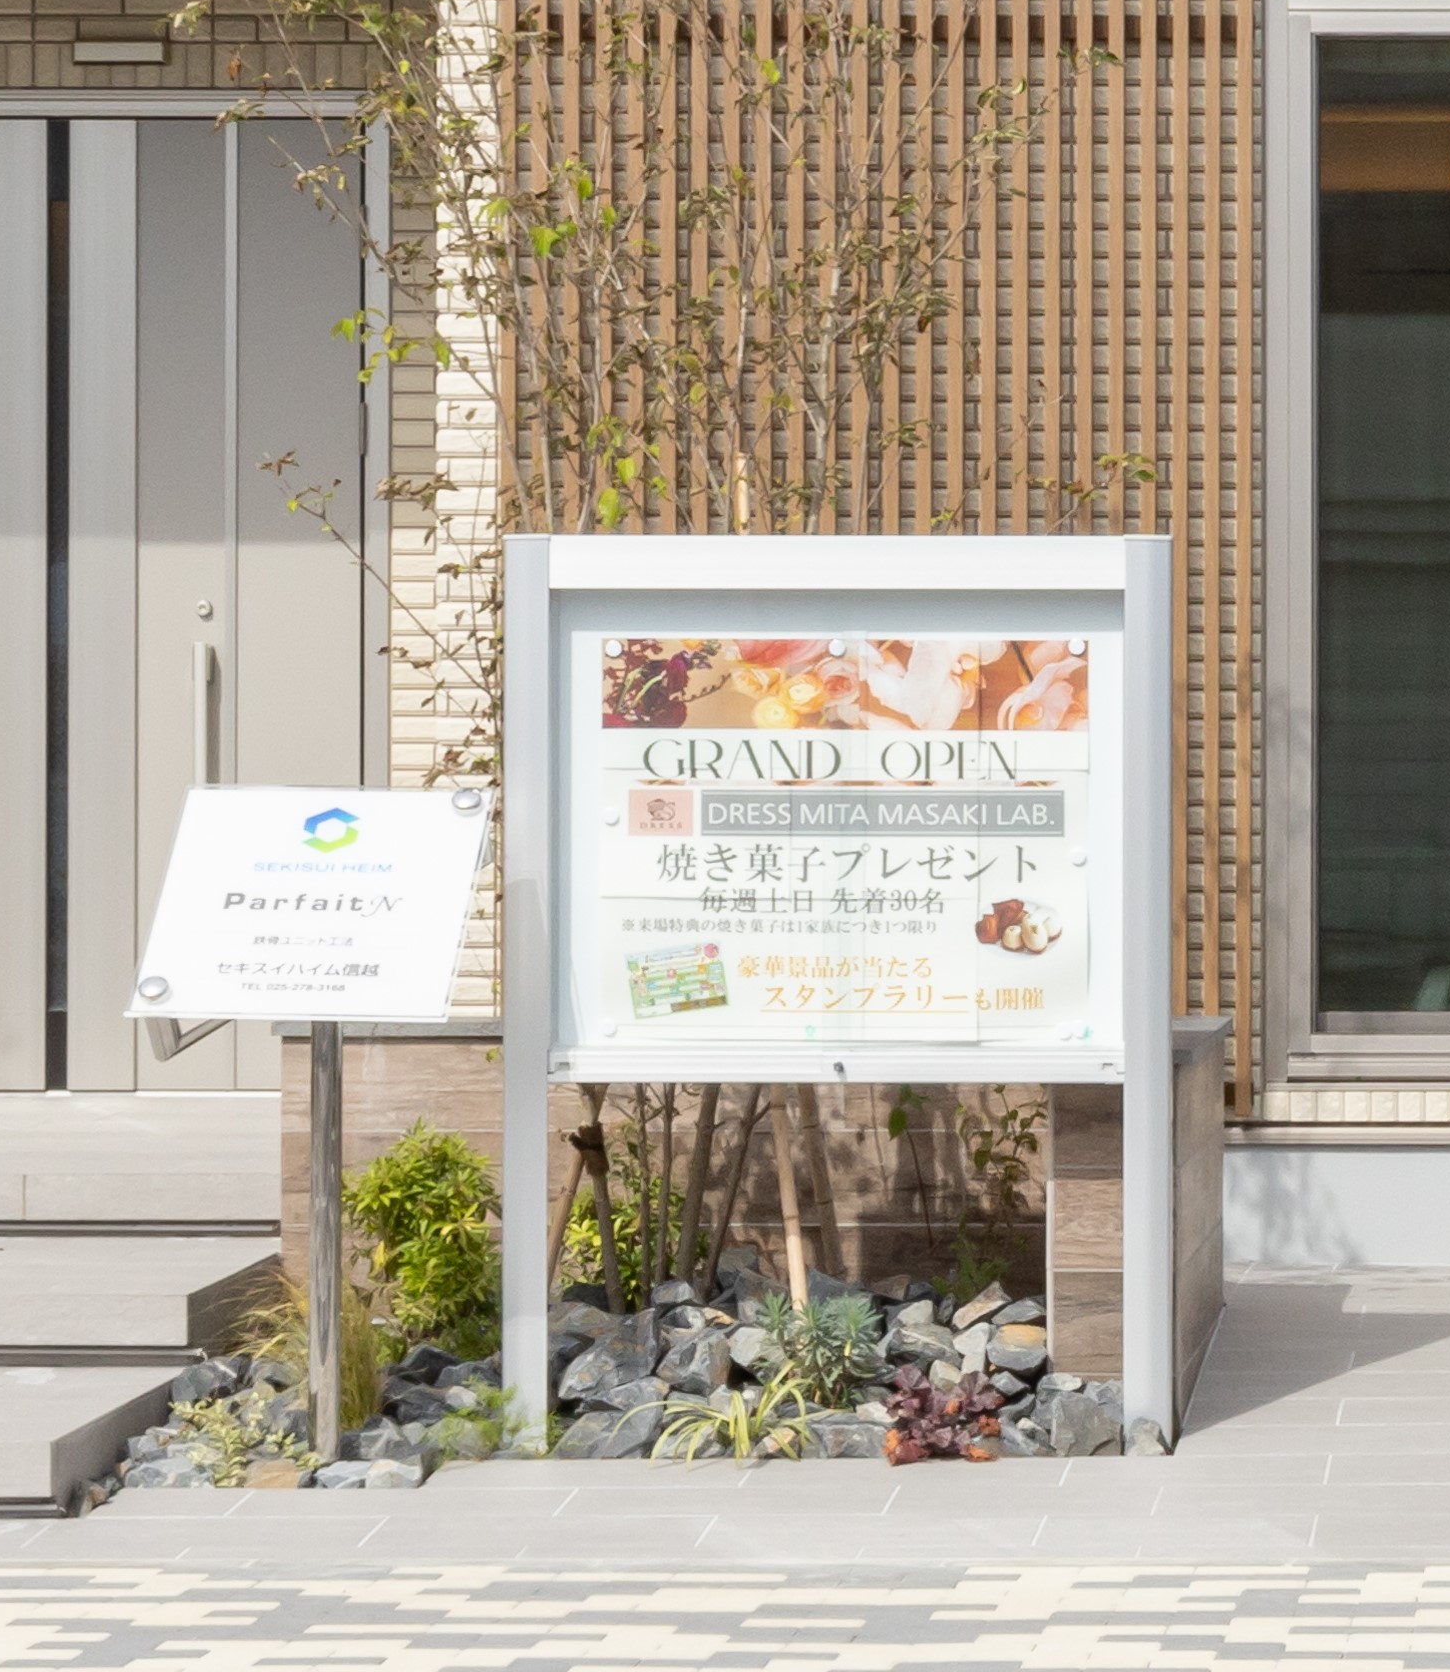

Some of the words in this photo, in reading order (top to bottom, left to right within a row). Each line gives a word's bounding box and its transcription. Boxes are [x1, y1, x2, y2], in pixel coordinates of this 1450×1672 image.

[642, 738, 843, 779] GRAND
[880, 740, 1019, 780] OPEN
[708, 802, 791, 825] DRESS
[800, 803, 870, 825] MITA
[878, 803, 987, 826] MASAKI
[996, 803, 1056, 826] LAB.
[253, 862, 336, 873] SEKISUI
[341, 862, 393, 873] HEIM
[656, 842, 1038, 883] 焼き菓子プレゼント
[699, 886, 815, 914] 毎週土日
[830, 888, 945, 915] 先着30名
[216, 962, 380, 977] セキスイハイム信越
[737, 955, 934, 979] 豪華景品が当たる
[241, 982, 262, 991] TEL
[764, 984, 1046, 1011] スタンプラリーも開催
